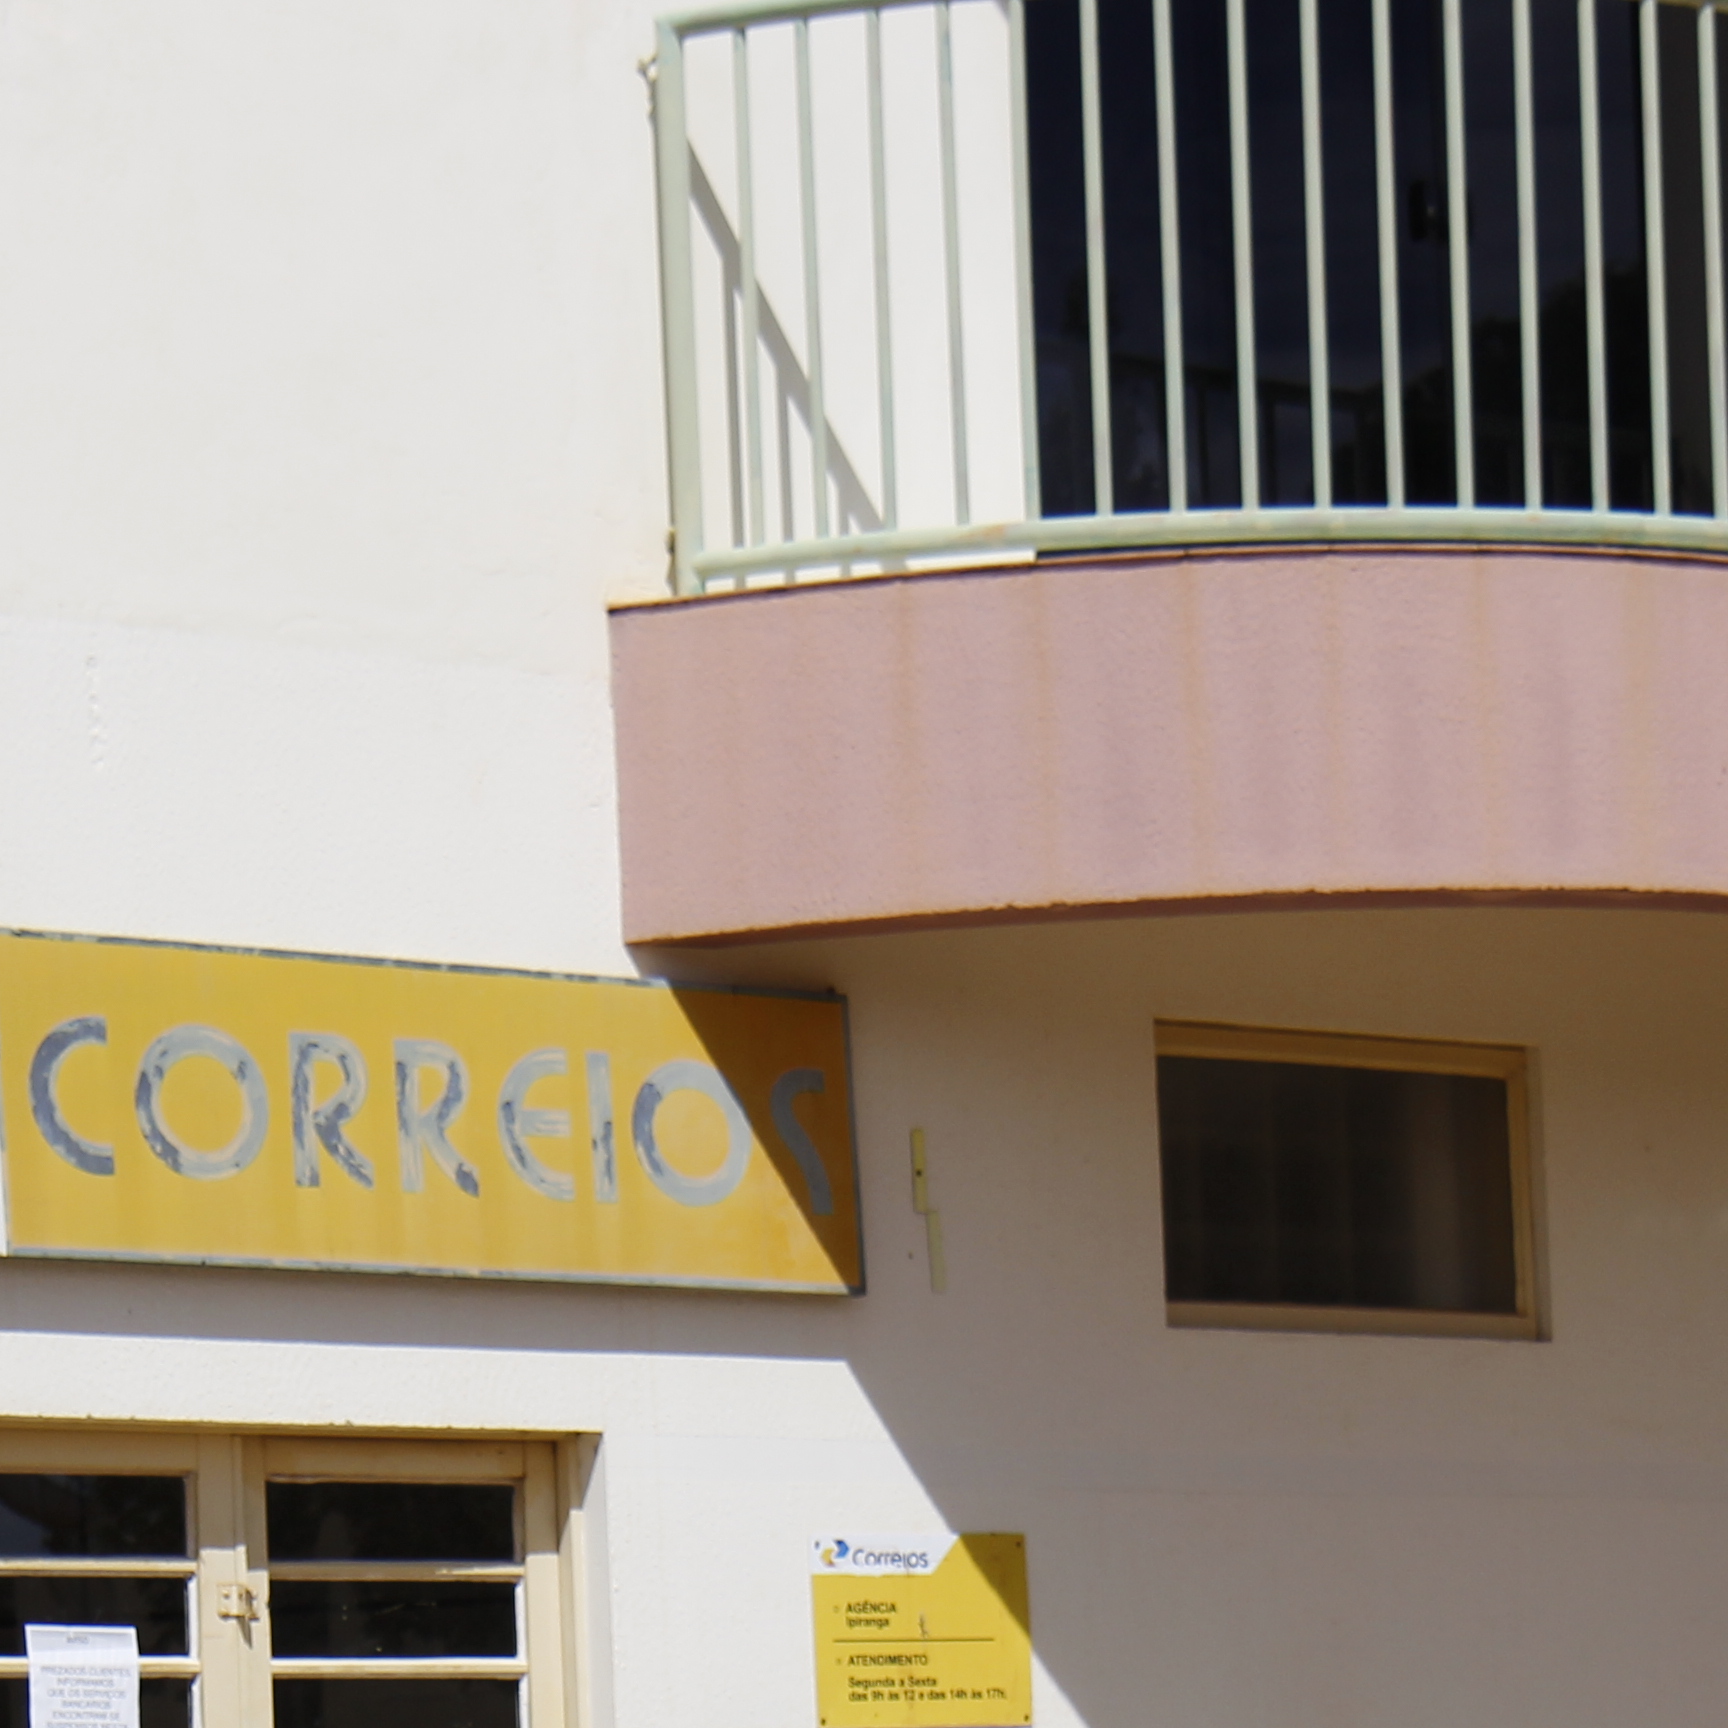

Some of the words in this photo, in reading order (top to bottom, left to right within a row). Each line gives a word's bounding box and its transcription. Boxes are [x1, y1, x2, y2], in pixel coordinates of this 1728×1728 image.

[28, 1014, 834, 1217] CORREIOS
[852, 1548, 928, 1569] Correios
[844, 1599, 896, 1613] AGÊNCIA
[845, 1615, 889, 1630] Ipiranga
[848, 1654, 928, 1666] ATENDIMENTO
[40, 1666, 85, 1675] PREZADOS
[848, 1676, 895, 1690] Segunda
[898, 1679, 905, 1687] a
[907, 1676, 937, 1687] Sexta
[47, 1687, 64, 1697] QUE
[67, 1688, 80, 1697] OS
[848, 1690, 868, 1701] das
[927, 1690, 946, 1700] das
[950, 1688, 967, 1699] 14h
